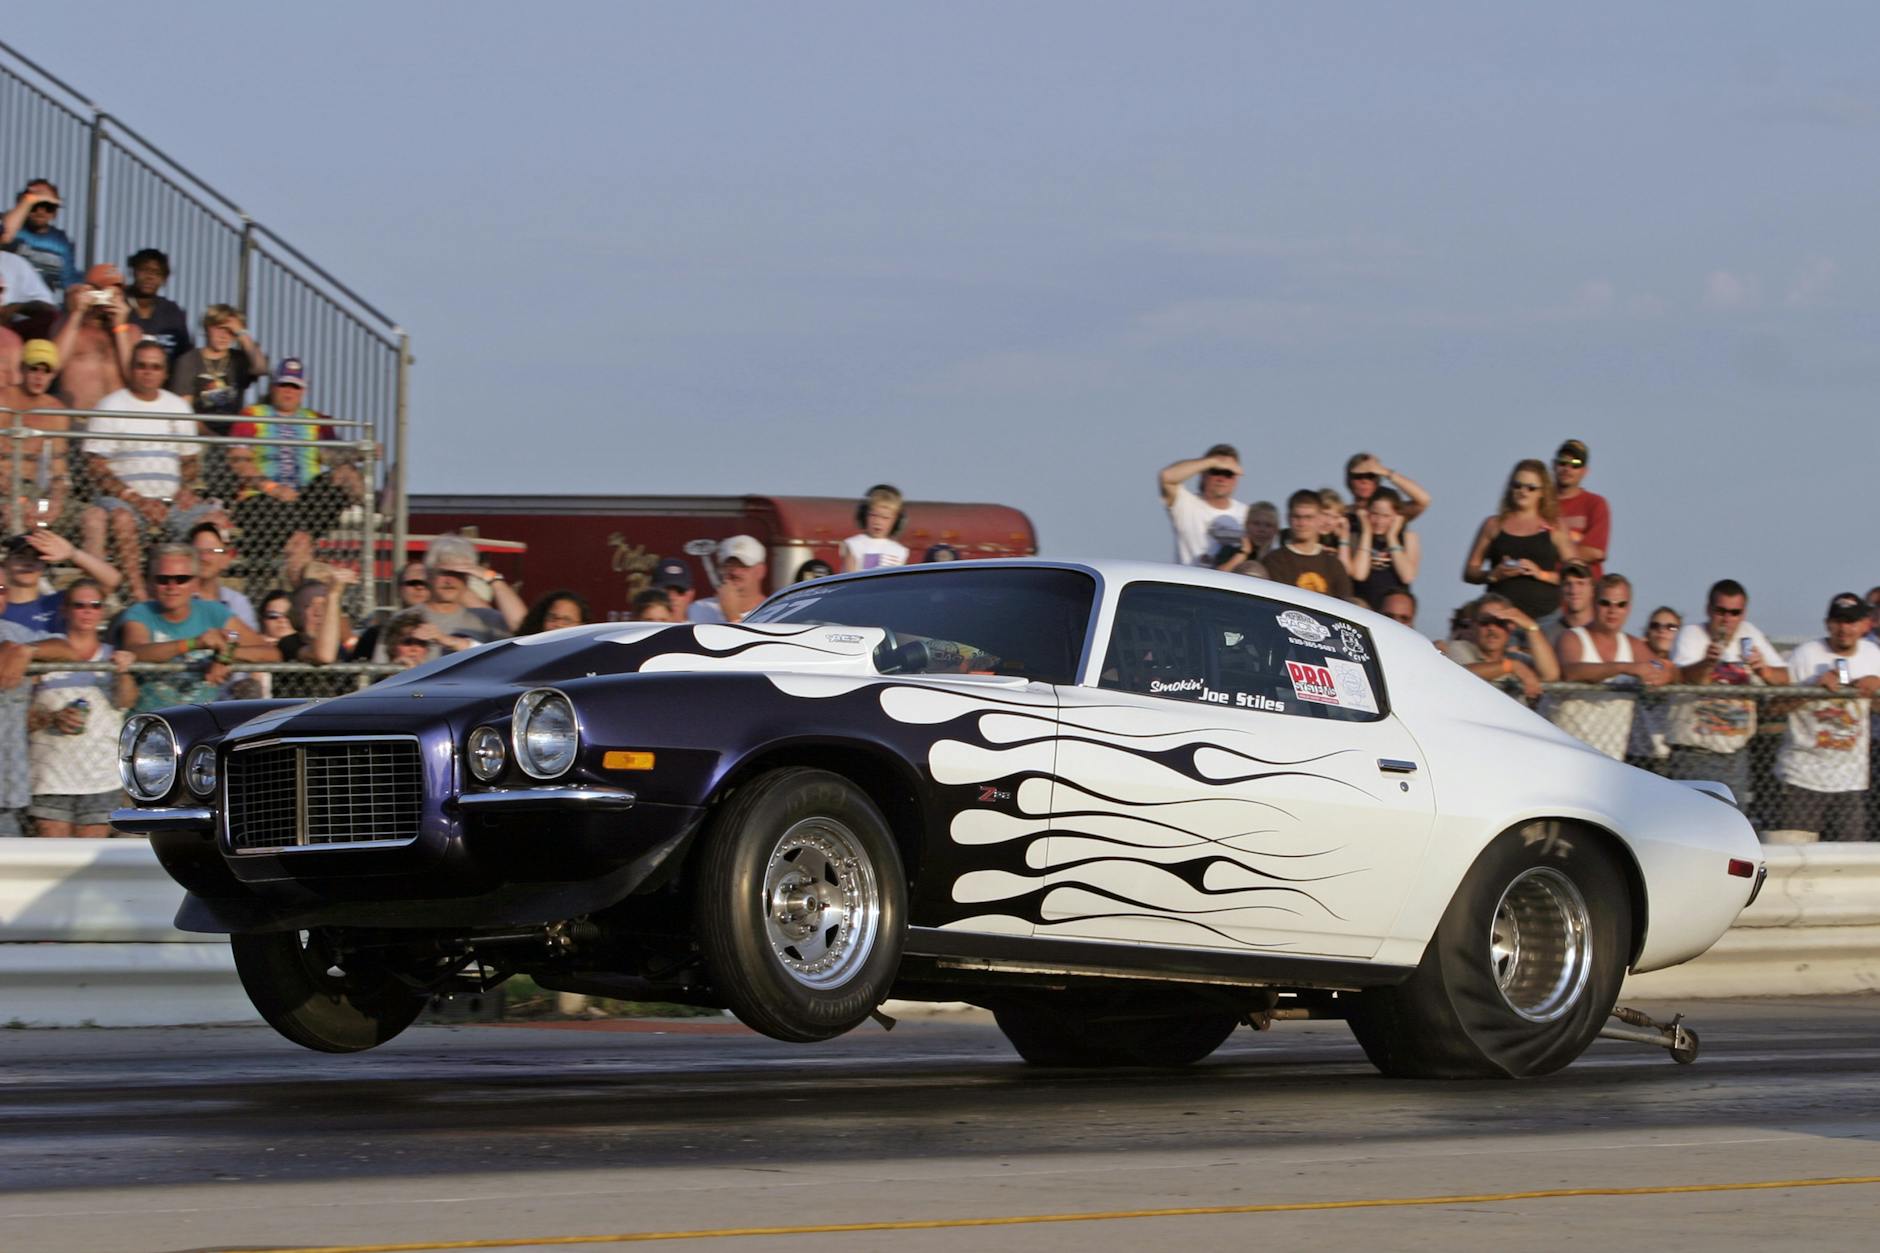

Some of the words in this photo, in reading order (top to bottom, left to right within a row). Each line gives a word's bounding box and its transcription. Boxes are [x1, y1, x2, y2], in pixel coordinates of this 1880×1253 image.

[1150, 678, 1203, 693] Smokin'
[1287, 662, 1334, 689] PRO
[1198, 687, 1229, 704] Joe
[1236, 692, 1285, 712] Stiles
[1294, 681, 1337, 698] SYSTEMS
